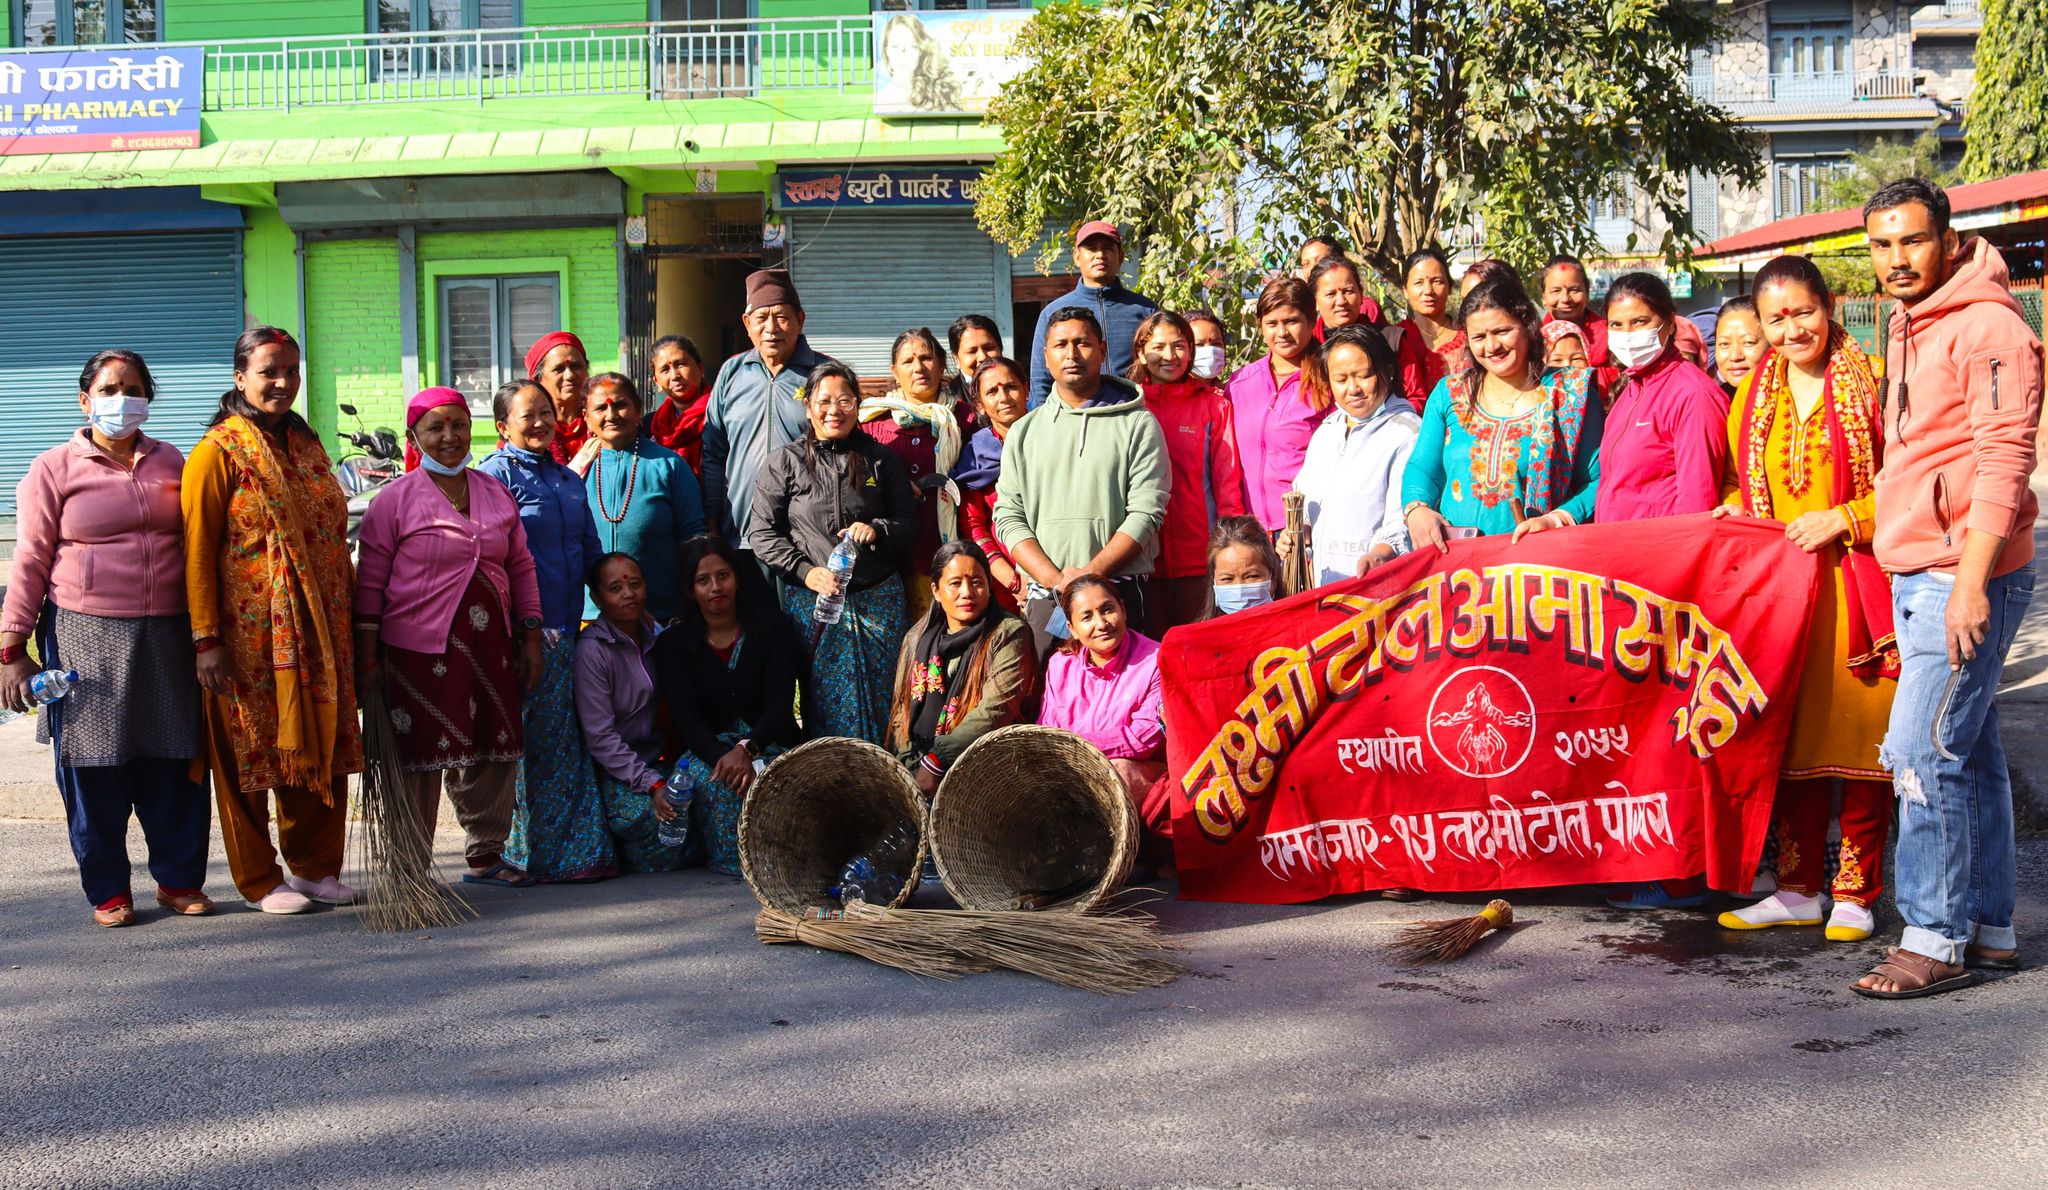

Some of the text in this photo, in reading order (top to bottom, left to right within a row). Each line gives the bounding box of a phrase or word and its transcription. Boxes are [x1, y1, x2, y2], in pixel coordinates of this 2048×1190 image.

[950, 43, 977, 57] SKY
[38, 55, 184, 92] फार्मेसी
[23, 98, 184, 122] PHARMACY
[847, 173, 893, 204] ब्युटी
[899, 174, 953, 199] पार्लर
[1311, 571, 1446, 698] टोल
[1449, 563, 1608, 666] आमा
[1554, 724, 1632, 766] २०५५
